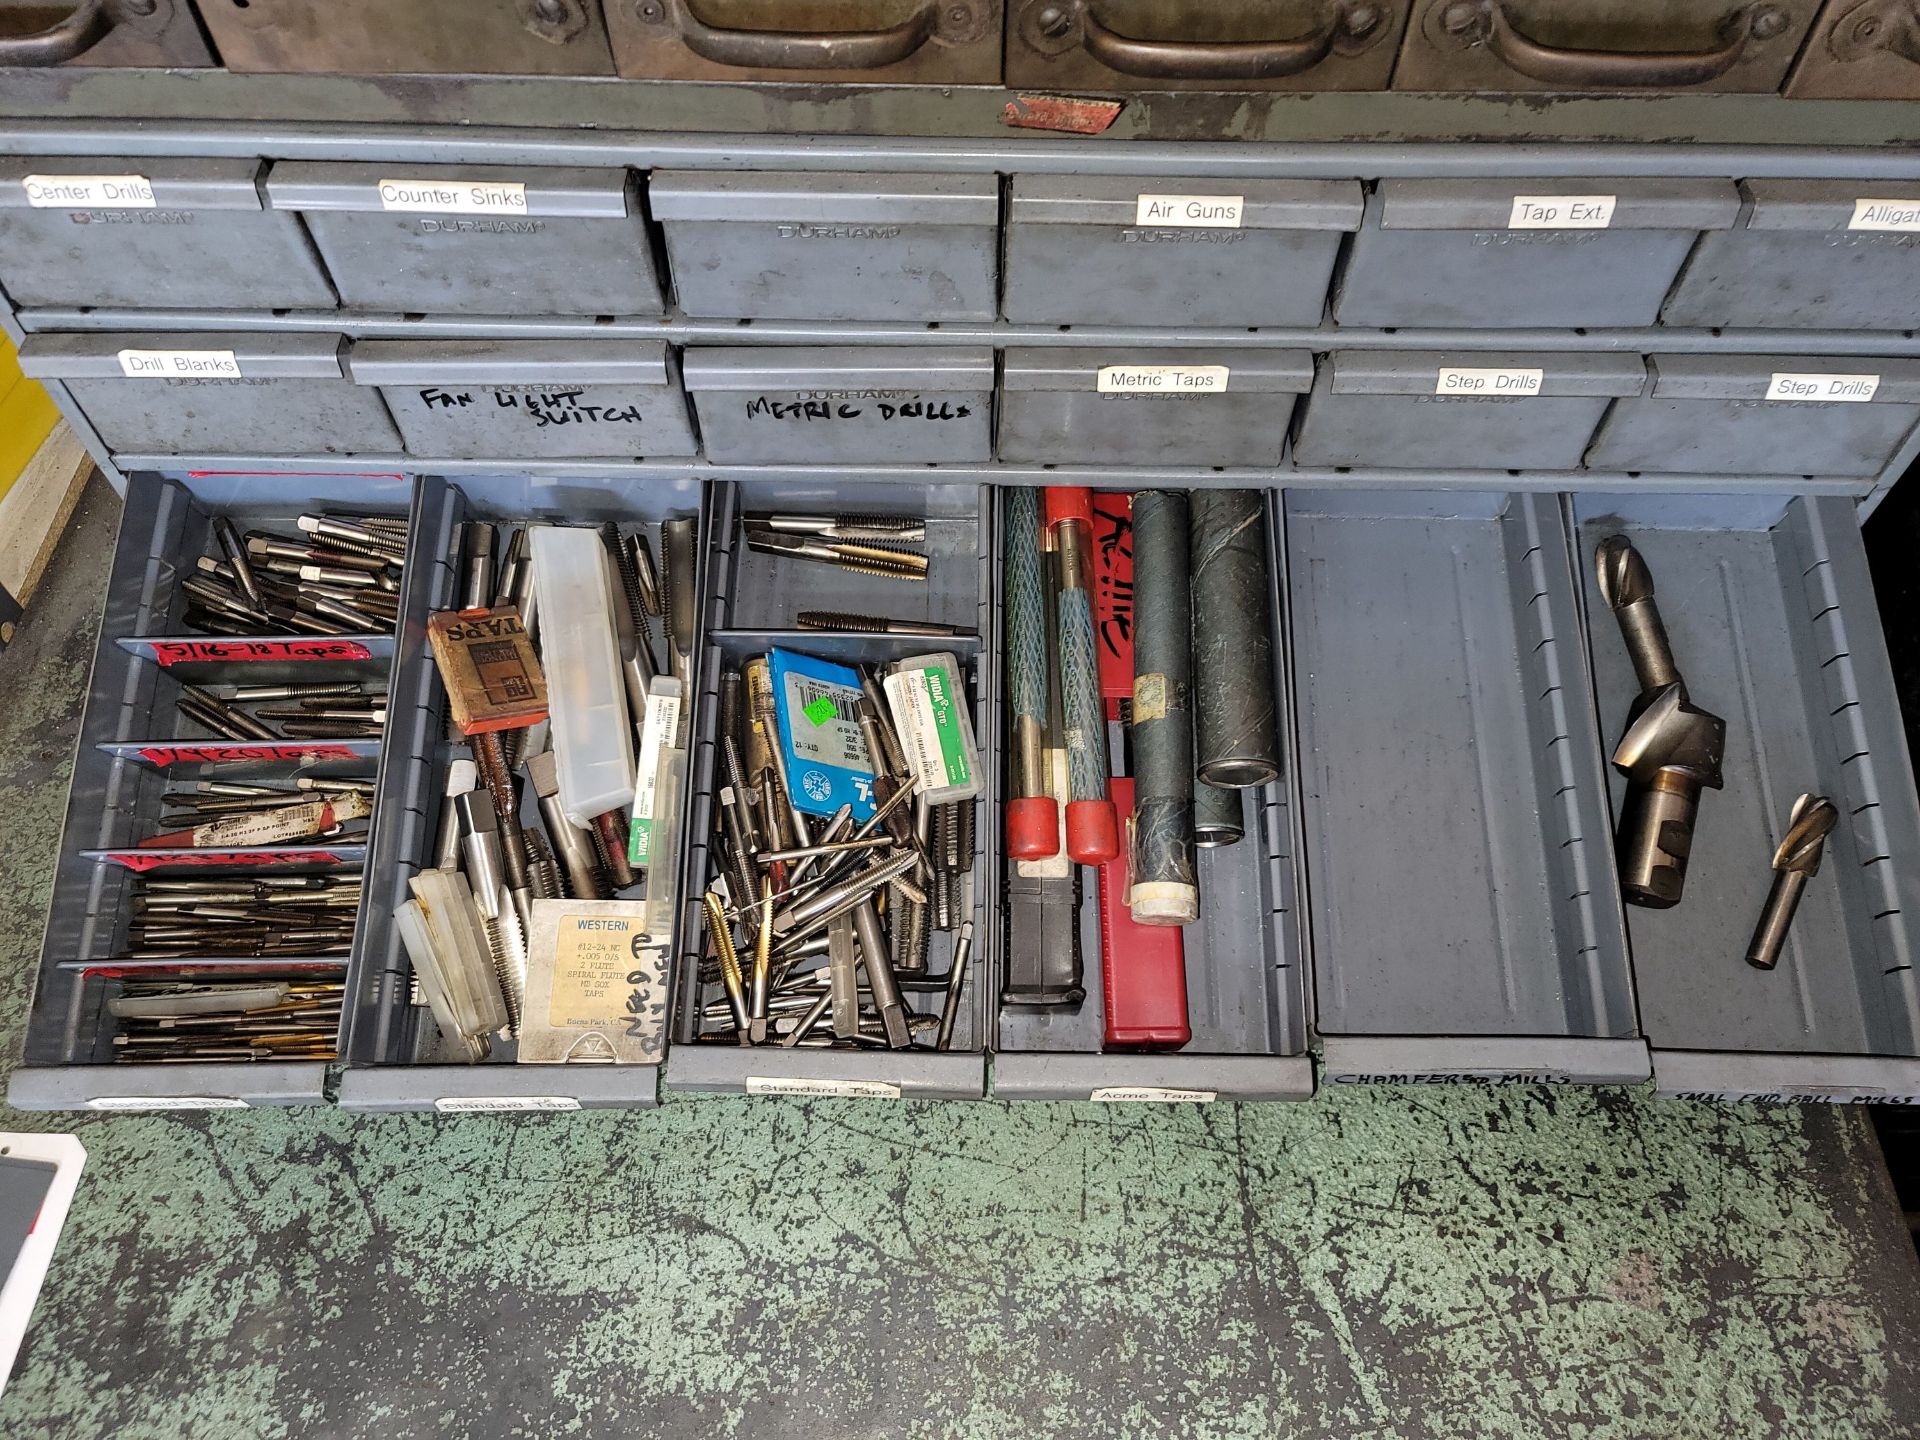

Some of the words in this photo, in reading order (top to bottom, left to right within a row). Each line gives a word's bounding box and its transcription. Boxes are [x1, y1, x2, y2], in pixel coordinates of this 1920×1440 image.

[27, 182, 91, 201] Center
[103, 183, 153, 201] Drills
[381, 185, 459, 204] Counter
[471, 187, 524, 207] Sinks
[1147, 201, 1174, 218] Air
[1186, 202, 1236, 219] Guns
[1521, 203, 1557, 223] Tap
[1569, 203, 1606, 221] Ext.
[129, 357, 165, 371] Drill
[173, 357, 235, 372] Blanks
[1111, 372, 1162, 386] Metric
[1173, 372, 1214, 388] Taps
[1446, 373, 1485, 390] Step
[1495, 375, 1538, 389] Drills
[1777, 379, 1818, 396] Step
[1828, 381, 1873, 395] Drills
[419, 388, 474, 410] FAN
[747, 396, 863, 421] METRIC
[446, 616, 526, 642] TAPS
[929, 673, 945, 703] WIDIA
[636, 829, 650, 857] WIDIA
[578, 919, 629, 931] WESTERN
[577, 943, 606, 951] #12-24
[609, 943, 621, 951] NC
[590, 962, 614, 970] FLUTE
[567, 970, 597, 979] SPIRAL
[600, 971, 625, 980] FLUTE
[584, 989, 605, 998] TAPS
[1500, 1073, 1572, 1085] MILLS
[760, 1084, 839, 1094] Standard
[849, 1087, 893, 1096] Taps
[1160, 1092, 1203, 1100] Taps
[444, 1102, 524, 1110] Standard
[532, 1101, 578, 1109] Taps
[1788, 1094, 1834, 1104] BALL
